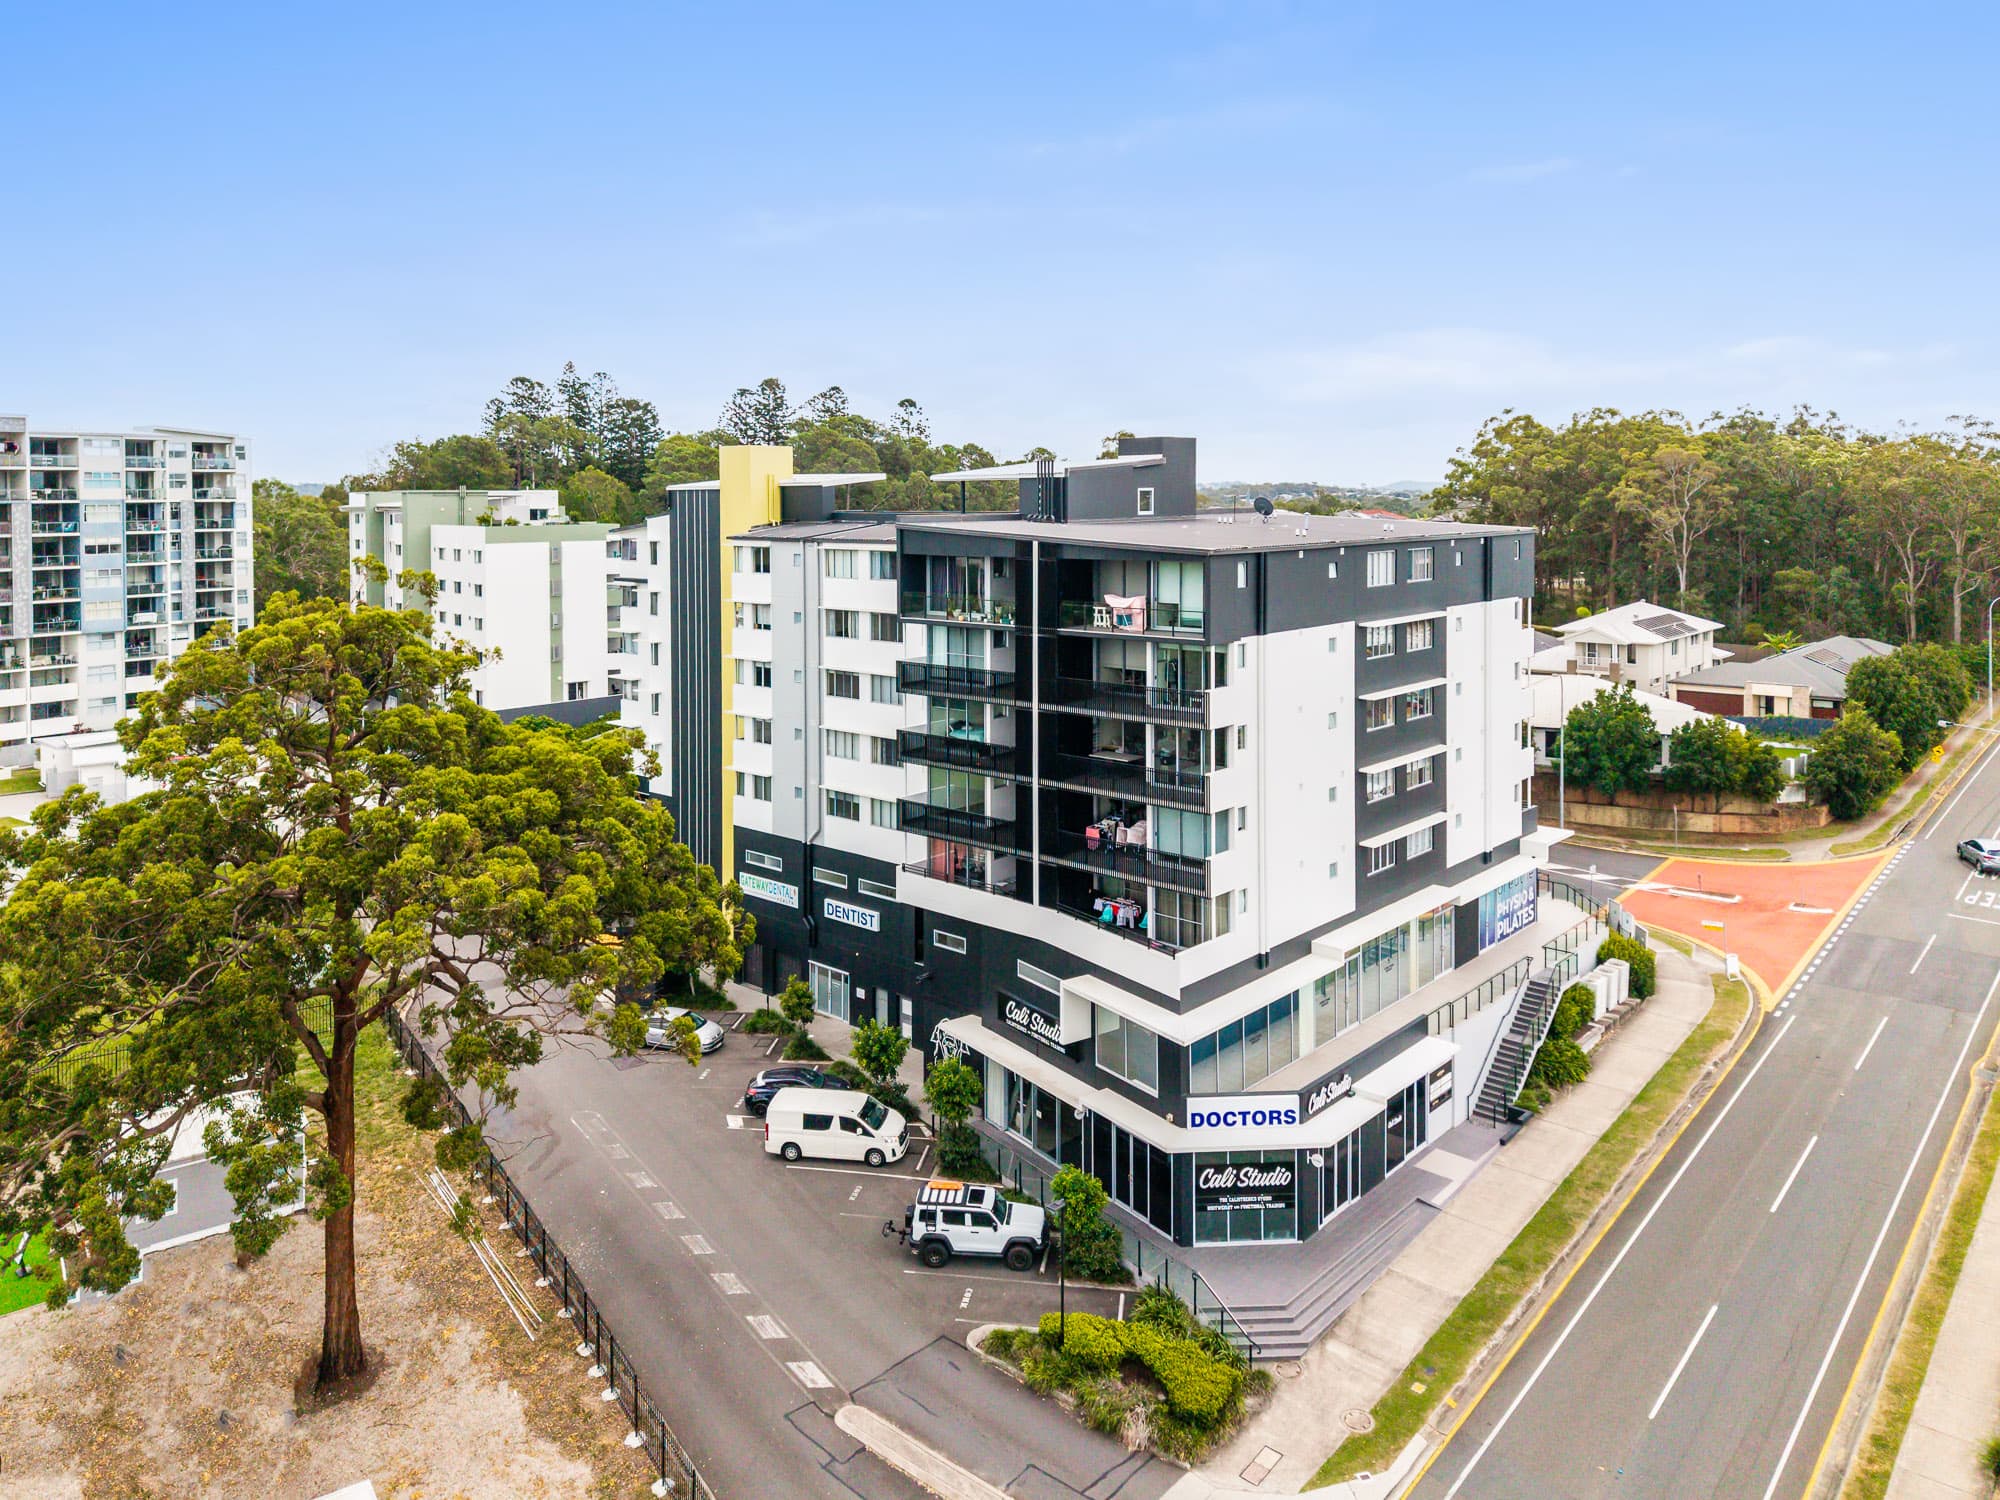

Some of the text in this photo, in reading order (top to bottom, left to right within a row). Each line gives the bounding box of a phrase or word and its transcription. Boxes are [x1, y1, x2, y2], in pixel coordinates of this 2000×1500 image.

[826, 903, 875, 928] DENTIST
[1497, 889, 1528, 917] PHYSIO
[1497, 904, 1535, 939] PILATES
[1006, 1001, 1061, 1042] Cali Studi
[1308, 1074, 1352, 1114] Cali Studio
[1190, 1109, 1297, 1128] DOCTORS
[1200, 1166, 1292, 1189] Cali Studio
